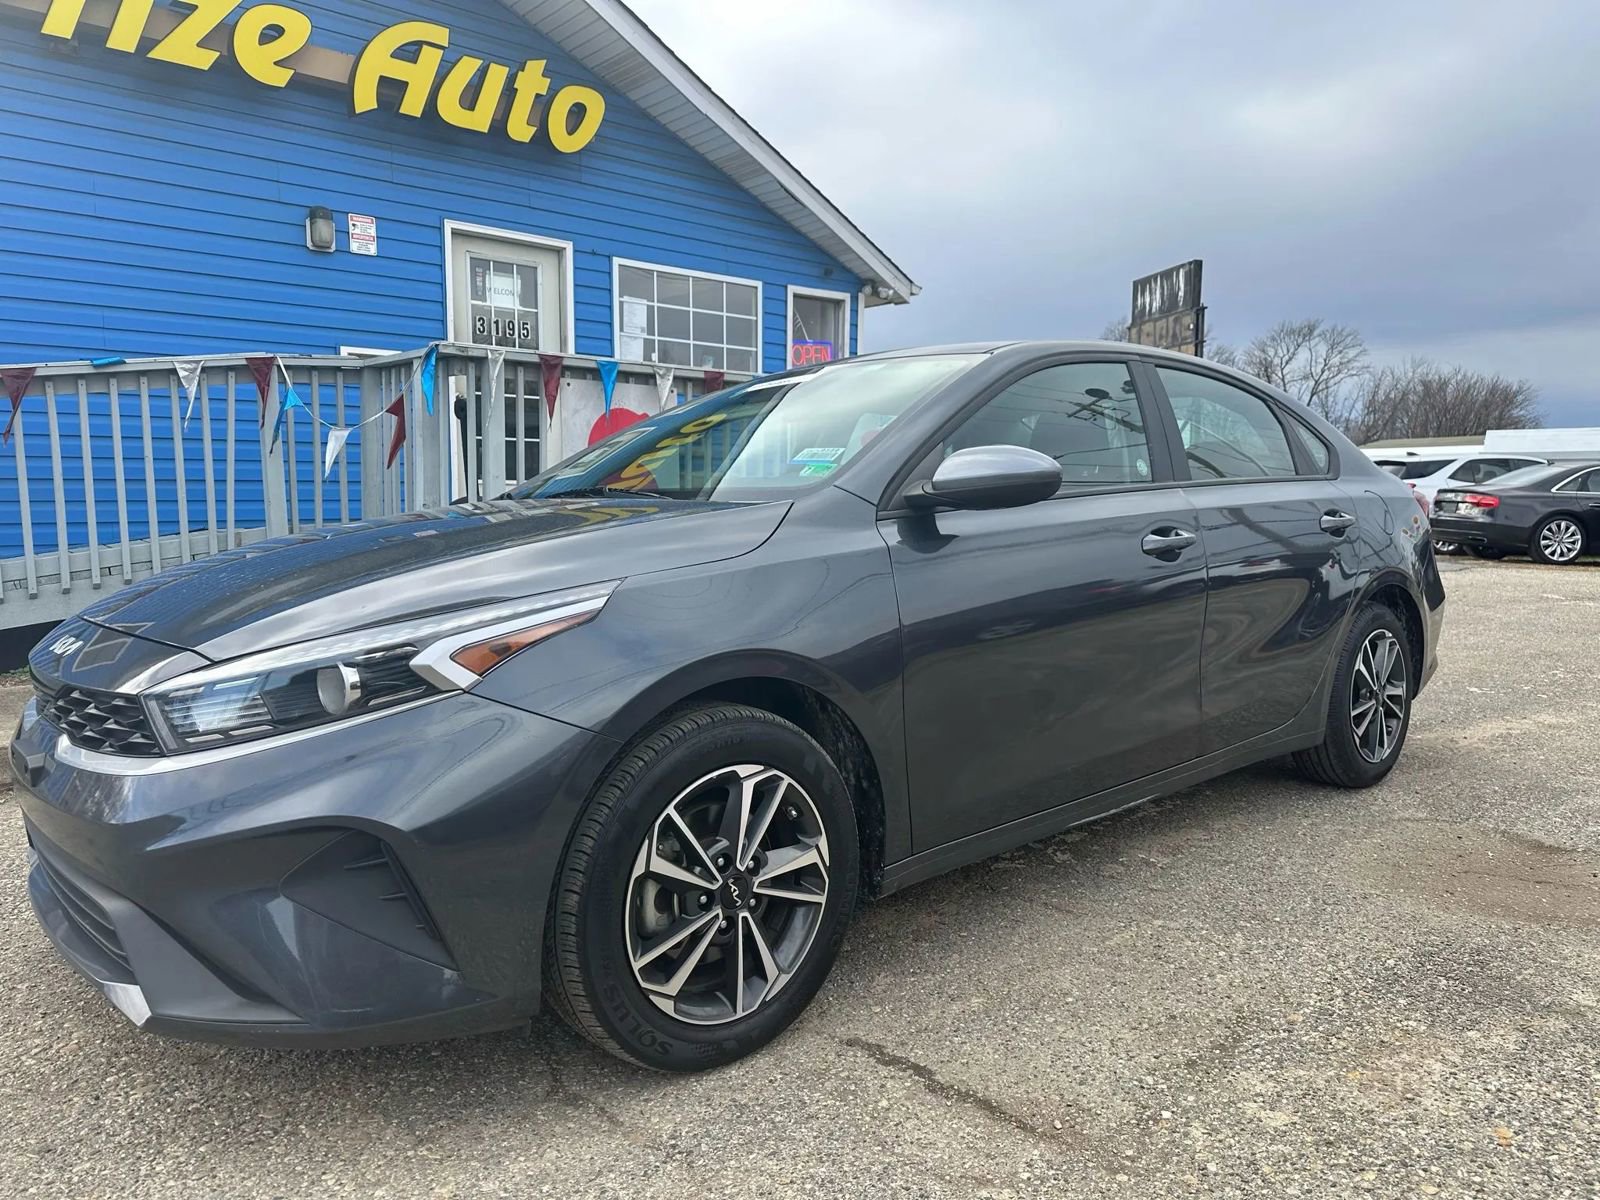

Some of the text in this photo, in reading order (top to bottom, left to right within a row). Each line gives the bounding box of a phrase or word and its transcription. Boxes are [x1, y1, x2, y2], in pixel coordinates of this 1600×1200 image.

[353, 20, 606, 154] Auto
[477, 316, 529, 339] 3195
[792, 344, 829, 366] OPEN
